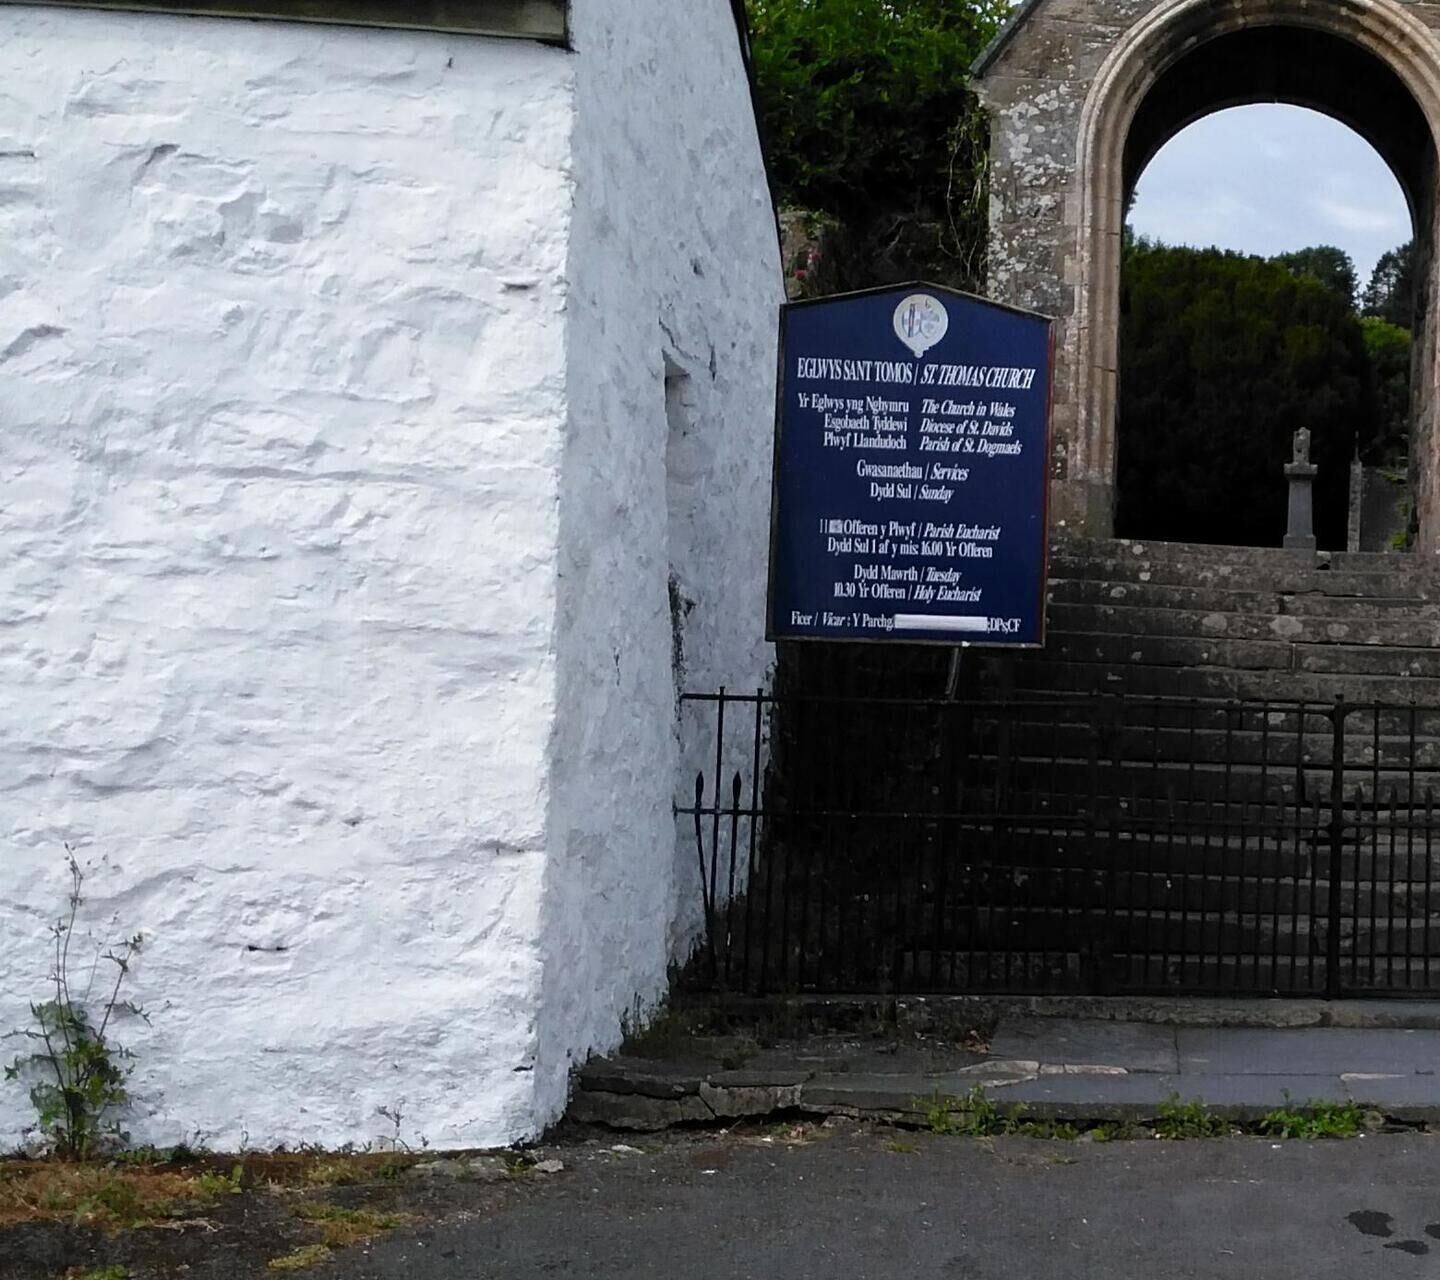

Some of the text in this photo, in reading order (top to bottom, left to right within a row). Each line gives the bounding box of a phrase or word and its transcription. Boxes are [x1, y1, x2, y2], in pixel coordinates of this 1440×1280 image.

[797, 357, 842, 380] EGLWYS
[844, 360, 872, 380] SANT
[875, 362, 912, 383] TOMOS
[938, 365, 986, 387] THOMAS
[985, 367, 1036, 389] CHURCH
[798, 393, 909, 415] Yr Eglwys yng Nghymru
[921, 399, 1016, 417] The Church in Wales
[824, 413, 907, 433] Esgobaeth Tyddewi
[920, 418, 955, 434] Diocese
[956, 420, 968, 434] of
[981, 421, 1014, 436] Davids
[824, 431, 906, 450] Plwyf Llandudoch
[919, 436, 950, 451] Parish
[951, 437, 964, 452] of
[977, 439, 1022, 457] Dogmaels
[857, 459, 922, 479] Gwasanaethau
[930, 462, 969, 481] Services
[870, 482, 894, 501] Dydd
[896, 483, 911, 498] Sul
[918, 484, 954, 504] Sunday
[844, 519, 877, 535] Offeren
[880, 525, 886, 539] y
[889, 521, 916, 540] Plwyf
[923, 523, 954, 538] Parish
[955, 524, 1000, 540] Eucharist
[827, 537, 851, 556] Dydd
[854, 538, 869, 553] Sul
[872, 538, 876, 554] 1
[879, 539, 889, 554] af
[891, 544, 898, 558] y
[946, 541, 957, 556] Yr
[959, 542, 992, 558] Offeren
[854, 564, 878, 582] Dydd
[881, 565, 918, 581] Mawrth
[926, 567, 962, 586] Tuesday
[834, 582, 855, 598] 10.30
[859, 583, 869, 598] Yr
[871, 583, 905, 599] Offeren
[914, 585, 936, 604] Holy
[936, 585, 982, 601] Eucharist
[791, 611, 812, 625] Ficer
[823, 612, 845, 626] Vicar
[853, 613, 860, 627] Y
